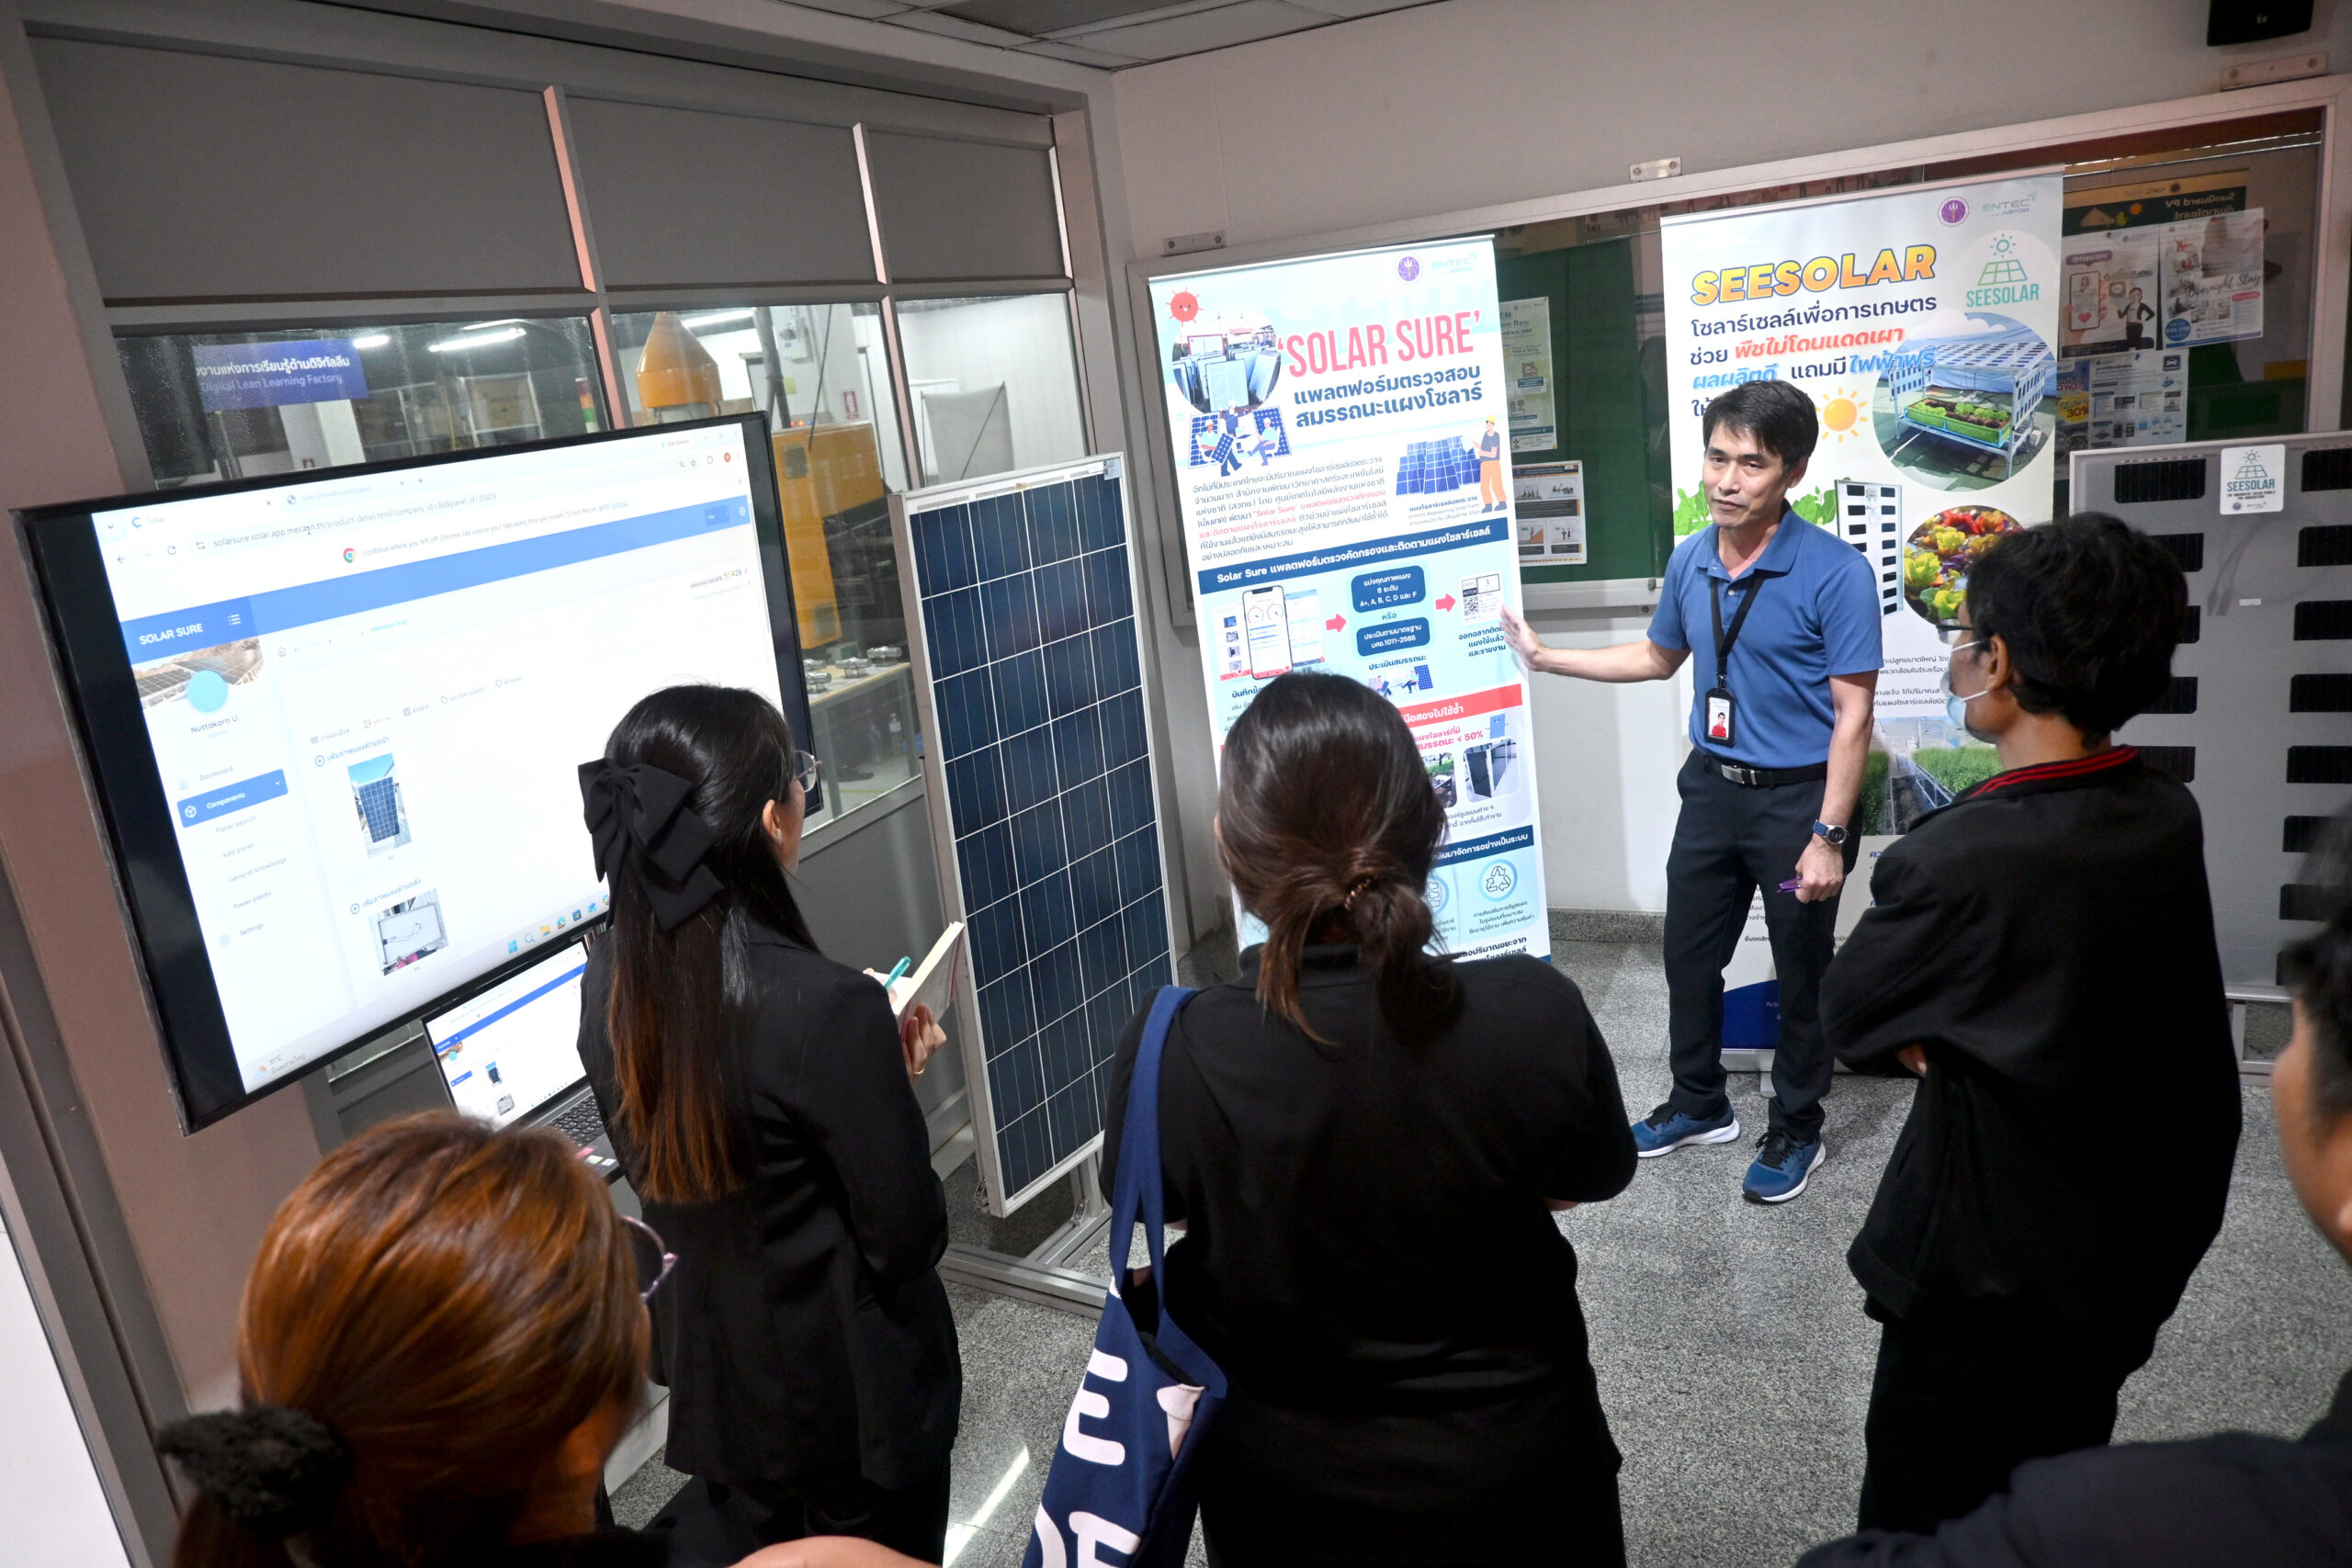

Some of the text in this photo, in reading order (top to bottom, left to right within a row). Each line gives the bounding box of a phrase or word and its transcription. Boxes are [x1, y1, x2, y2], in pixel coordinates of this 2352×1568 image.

[1690, 243, 1937, 307] SEESOLAR
[1965, 283, 2040, 309] SEESOLAR
[1690, 294, 1938, 337] โซลาร์เซลล์เพื่อการเกษตร
[1690, 322, 1904, 367] ช่วย พืชไม่โดนแดดเผา
[1791, 355, 1847, 381] แถมมี
[1849, 345, 1938, 376] ไฟฟ้าฟรี
[237, 378, 261, 389] Lean
[264, 376, 306, 389] Learning
[308, 374, 343, 385] Factory
[1293, 365, 1481, 405] แพลตฟอร์มตรวจสอบ
[1295, 381, 1483, 428] สมรรถนะแผงโซลาร์
[2227, 479, 2275, 491] SEESOLAR
[1194, 491, 1234, 505] จำนวนมาก
[1195, 503, 1227, 516] แห่งชาติ
[1259, 496, 1272, 505] โดย
[1229, 511, 1252, 523] พัฒนา
[363, 546, 389, 557] Continue
[390, 543, 407, 552] where
[409, 540, 419, 549] you
[420, 537, 430, 547] left
[440, 531, 461, 541] Chrome
[514, 519, 527, 530] every
[528, 517, 538, 525] time
[1216, 525, 1491, 584] Solar Sure แพลตฟอร์มตรวจคัดกรองและติดตามแผงโซลาร์เซลล์
[1383, 583, 1398, 592] ระดับ
[1382, 611, 1397, 621] หรือ
[139, 623, 203, 645] SOLAR SURE
[1363, 624, 1422, 640] ประเมินตามมาตรฐาน
[1468, 634, 1505, 648] แผงใช้แล้ว
[1468, 644, 1506, 657] และรายงาน
[1368, 654, 1427, 671] ประเมินสมรรถนะ
[190, 717, 230, 734] Nuttakarn
[1464, 730, 1484, 741] 50%
[199, 765, 234, 782] Dashboard
[207, 791, 245, 809] Components
[215, 815, 257, 834] Panel search
[222, 842, 254, 858] Add panel
[228, 857, 288, 883] General knowledge
[232, 891, 272, 910] Power plants
[239, 922, 265, 937] Settings
